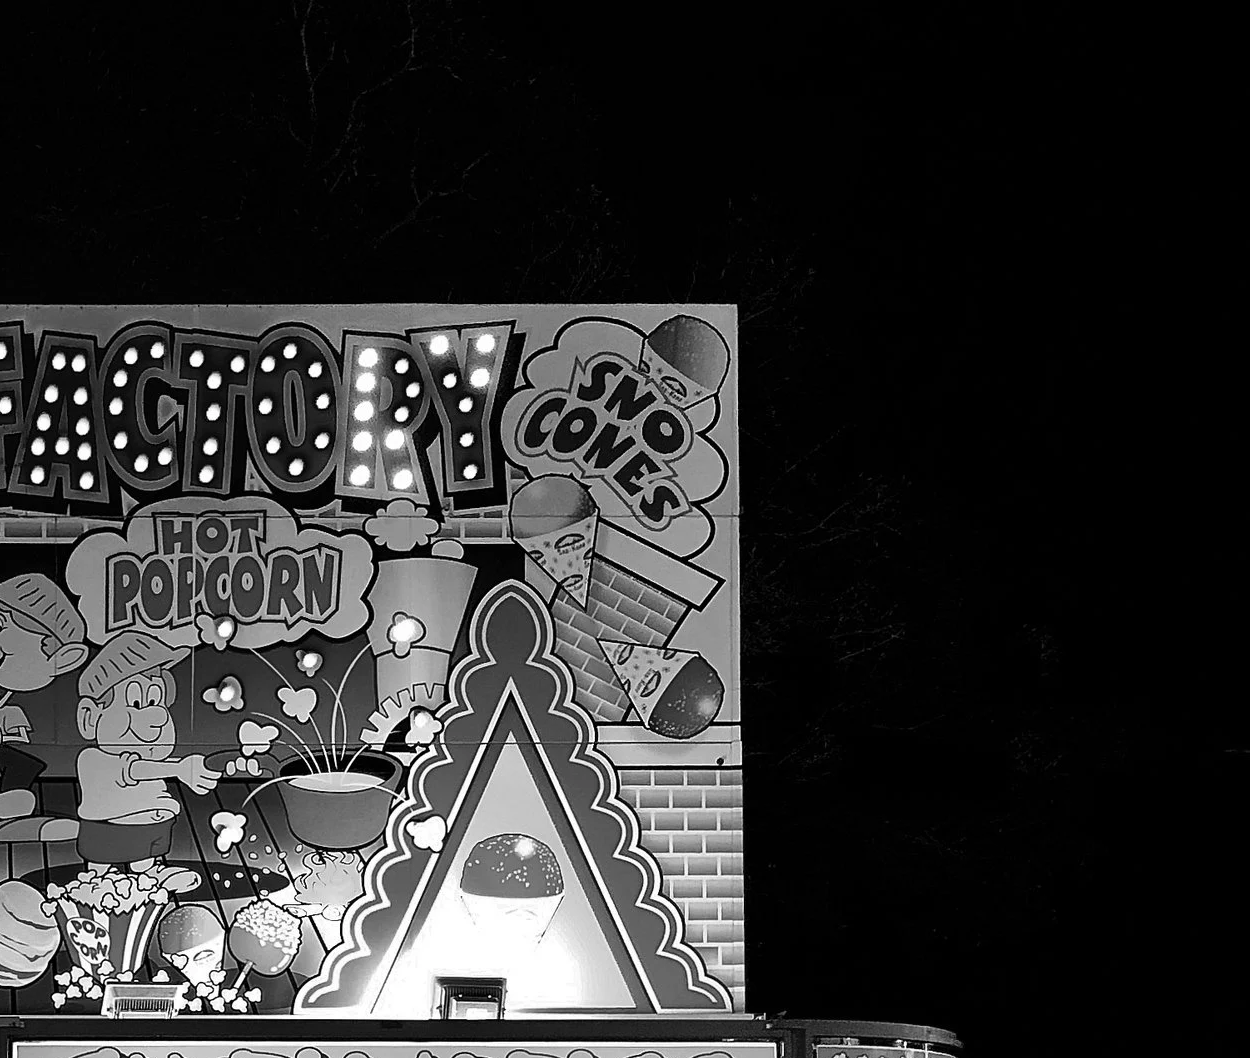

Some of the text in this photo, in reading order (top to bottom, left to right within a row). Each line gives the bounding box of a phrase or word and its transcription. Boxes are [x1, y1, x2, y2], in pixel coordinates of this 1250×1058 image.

[577, 361, 685, 454] SNO
[524, 398, 680, 522] CONES
[154, 512, 266, 555] HOT
[106, 546, 342, 631] POPCORN
[70, 933, 107, 961] CORN
[71, 920, 106, 939] POP
